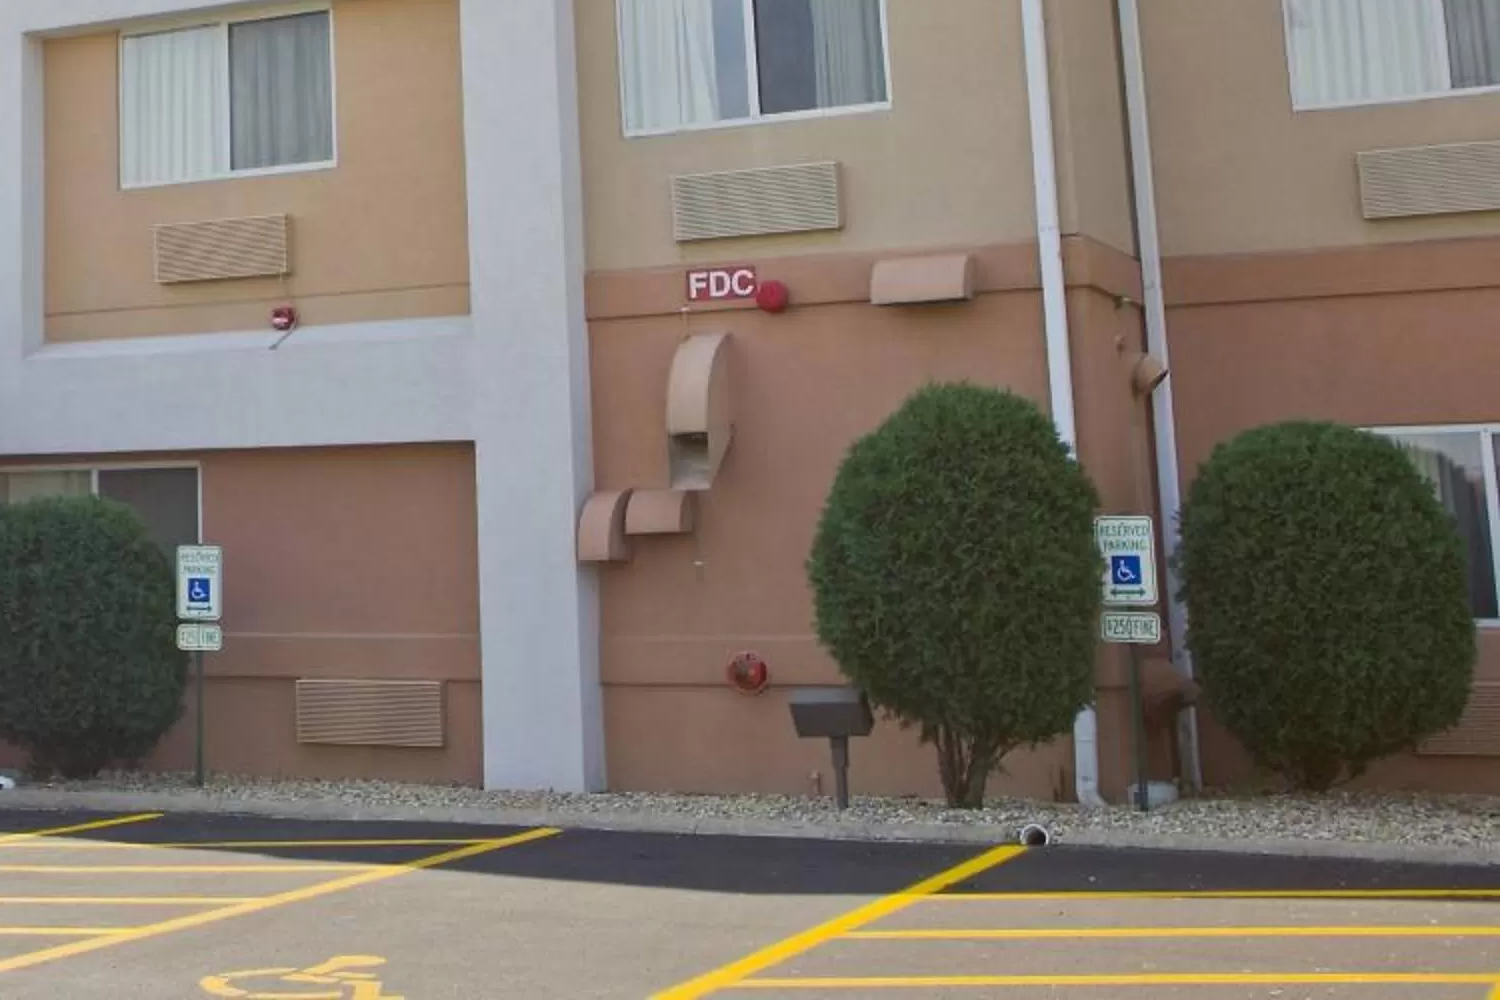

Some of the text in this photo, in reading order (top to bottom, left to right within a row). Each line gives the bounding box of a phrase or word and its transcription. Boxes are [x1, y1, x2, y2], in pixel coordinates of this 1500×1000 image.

[688, 269, 754, 299] FDC
[1100, 524, 1149, 537] RESERVED
[1103, 539, 1148, 551] PARKING
[1107, 618, 1154, 636] $250 FINE
